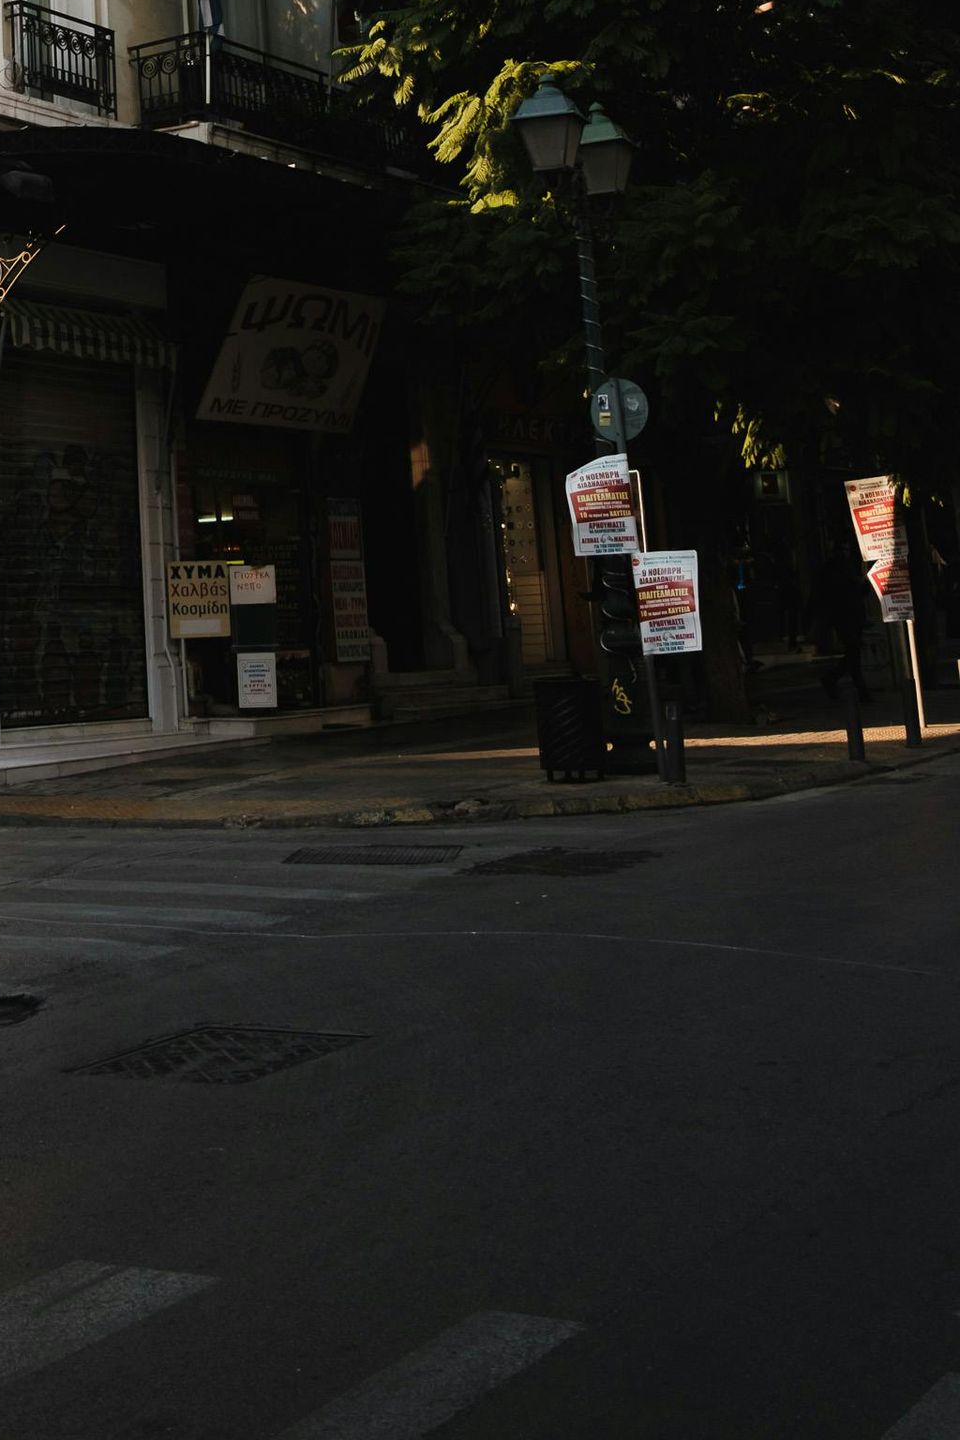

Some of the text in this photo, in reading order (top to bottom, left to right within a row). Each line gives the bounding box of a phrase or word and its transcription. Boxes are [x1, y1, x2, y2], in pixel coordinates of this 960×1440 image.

[241, 294, 377, 357] ΨΩΜΙ
[210, 397, 247, 414] ΜΕ
[170, 564, 226, 580] ΧΥΜΑ
[171, 581, 227, 598] Χαλβάς
[172, 600, 228, 618] Κοσμίδη
